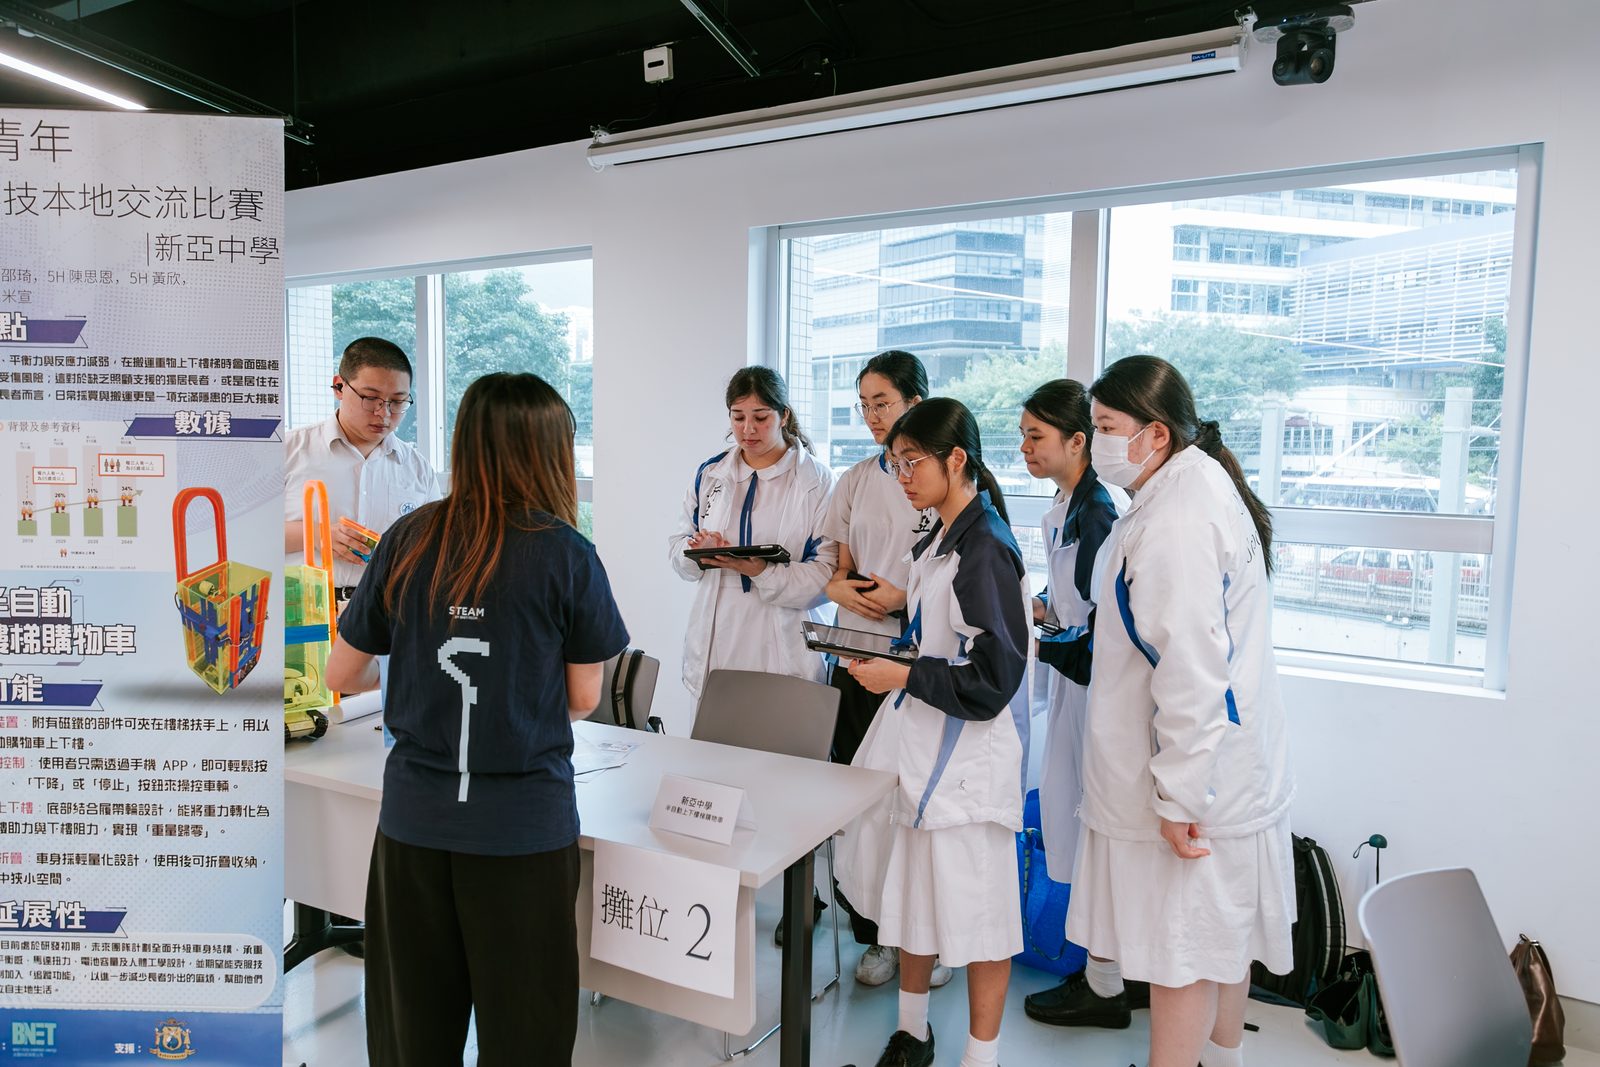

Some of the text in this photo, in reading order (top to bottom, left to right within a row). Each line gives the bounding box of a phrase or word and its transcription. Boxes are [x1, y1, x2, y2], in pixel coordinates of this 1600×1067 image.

[0, 118, 72, 162] 青年
[4, 181, 264, 222] 技本地交流比賽
[47, 270, 65, 283] 5H
[129, 272, 149, 285] 5H
[174, 410, 232, 436] 數據
[448, 606, 485, 617] STEAM
[0, 757, 157, 771] 控制：使用者只需透過手機
[681, 796, 713, 810] 新亞中學
[600, 883, 713, 961] 攤位 2
[12, 1022, 57, 1045] BNET
